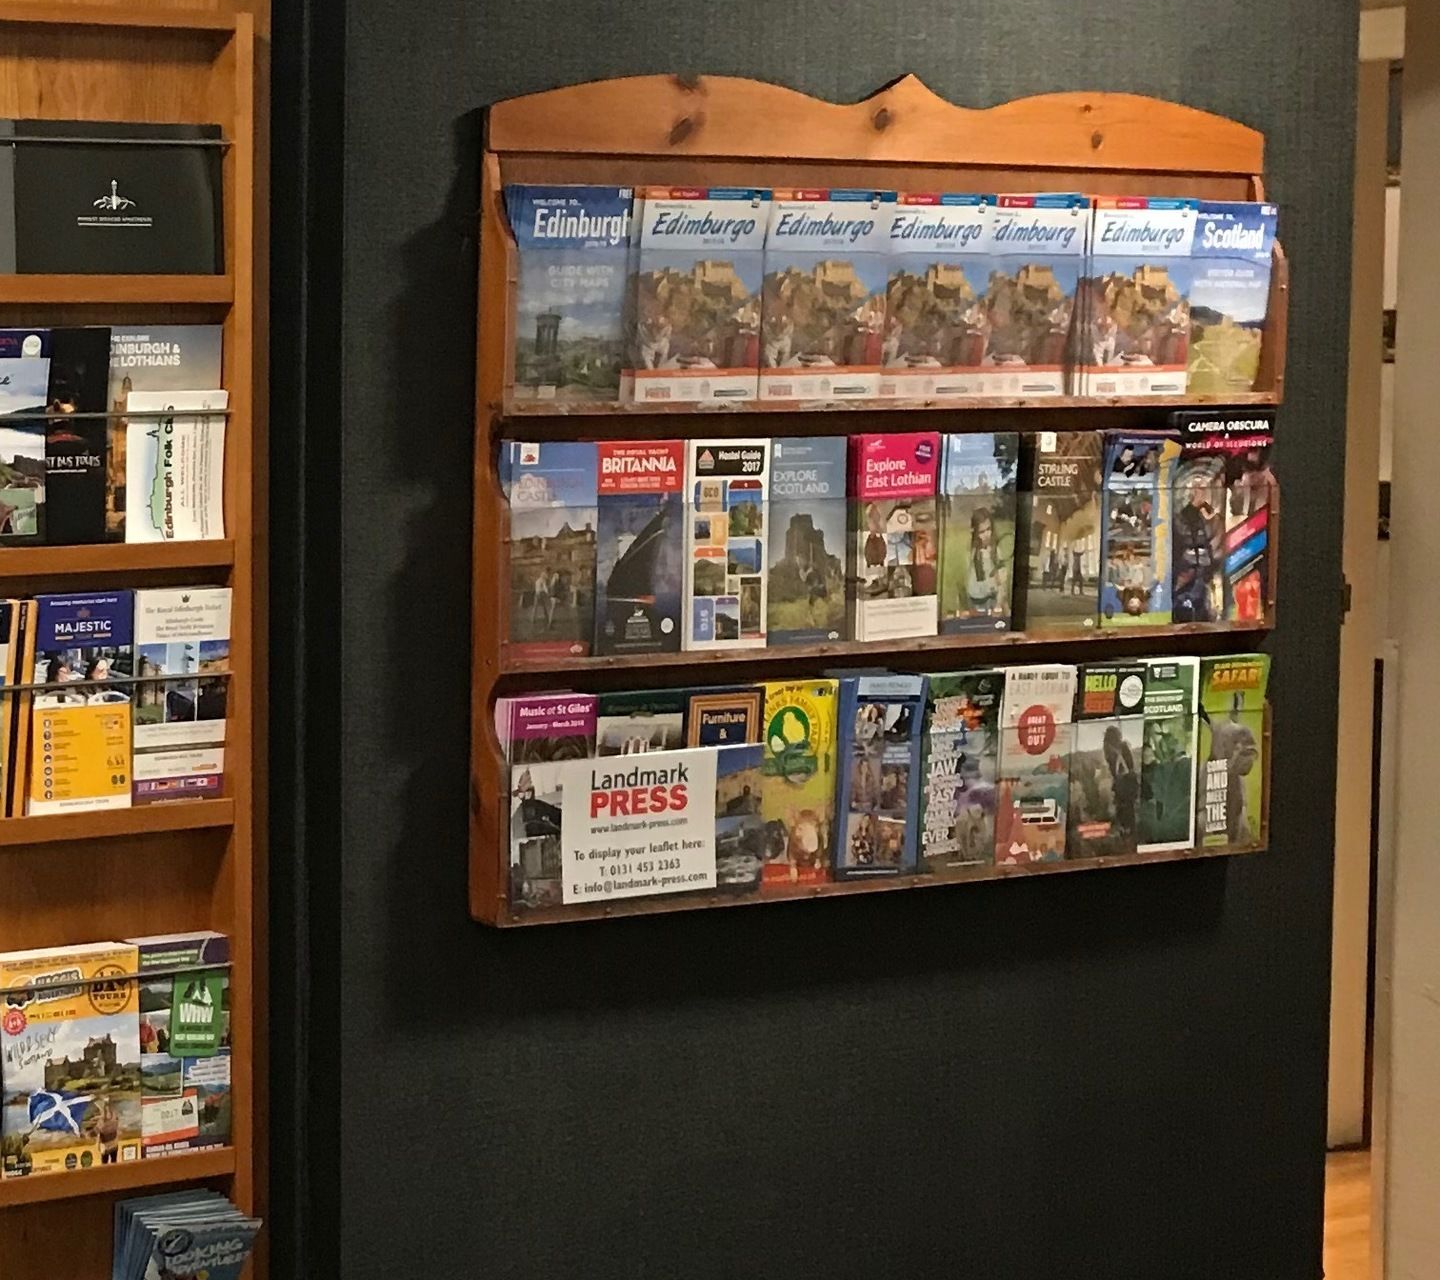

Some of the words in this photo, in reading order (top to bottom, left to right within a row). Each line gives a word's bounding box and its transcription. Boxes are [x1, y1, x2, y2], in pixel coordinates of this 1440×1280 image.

[619, 189, 633, 199] FREE
[652, 211, 755, 243] Edimburgo
[775, 212, 875, 243] Edimburgo
[890, 216, 983, 247] Edimburgo
[1101, 221, 1185, 249] Edimburgo
[1202, 221, 1265, 250] Scotland
[548, 265, 582, 277] GUIDE
[550, 278, 576, 288] CITY
[110, 342, 170, 355] DINBURGH
[121, 355, 180, 367] LOTHIANS
[1188, 421, 1225, 433] CAMERA
[1226, 420, 1269, 431] OBSCURA
[164, 440, 173, 468] Folk
[718, 450, 740, 460] Hostel
[741, 449, 762, 460] Guide
[75, 456, 100, 467] TOURS
[602, 456, 677, 473] BRITANNIA
[742, 461, 760, 473] 2017
[865, 458, 907, 474] Explore
[773, 470, 817, 483] EXPLORE
[1038, 464, 1078, 475] STIRLING
[865, 475, 888, 489] East
[890, 471, 932, 487] Lothian
[1038, 476, 1071, 487] CASTLE
[773, 482, 829, 494] SCOTLAND
[164, 471, 174, 539] Edinburgh
[55, 620, 112, 633] MAJESTIC
[519, 707, 545, 717] Music
[567, 703, 592, 714] Giles'
[1144, 704, 1183, 714] SCOTLAND
[703, 712, 746, 725] Furniture
[719, 728, 728, 739] &
[1027, 735, 1046, 746] OUT
[932, 759, 957, 776] JAW
[1207, 759, 1228, 770] COME
[591, 762, 689, 790] Landmark
[1207, 772, 1228, 790] AND
[590, 784, 688, 818] PRESS
[1206, 789, 1227, 803] MEET
[1206, 804, 1227, 821] THE
[591, 817, 688, 834] www.landmark-press.com
[922, 831, 949, 845] EVER
[574, 850, 585, 861] To
[589, 846, 621, 861] display
[625, 846, 645, 856] your
[650, 841, 678, 853] leaflet
[610, 864, 632, 875] 0131
[637, 861, 654, 873] 453
[658, 858, 681, 870] 2363
[573, 884, 582, 894] E:
[584, 871, 708, 893] info@landmark-press.com
[92, 979, 128, 992] DAY
